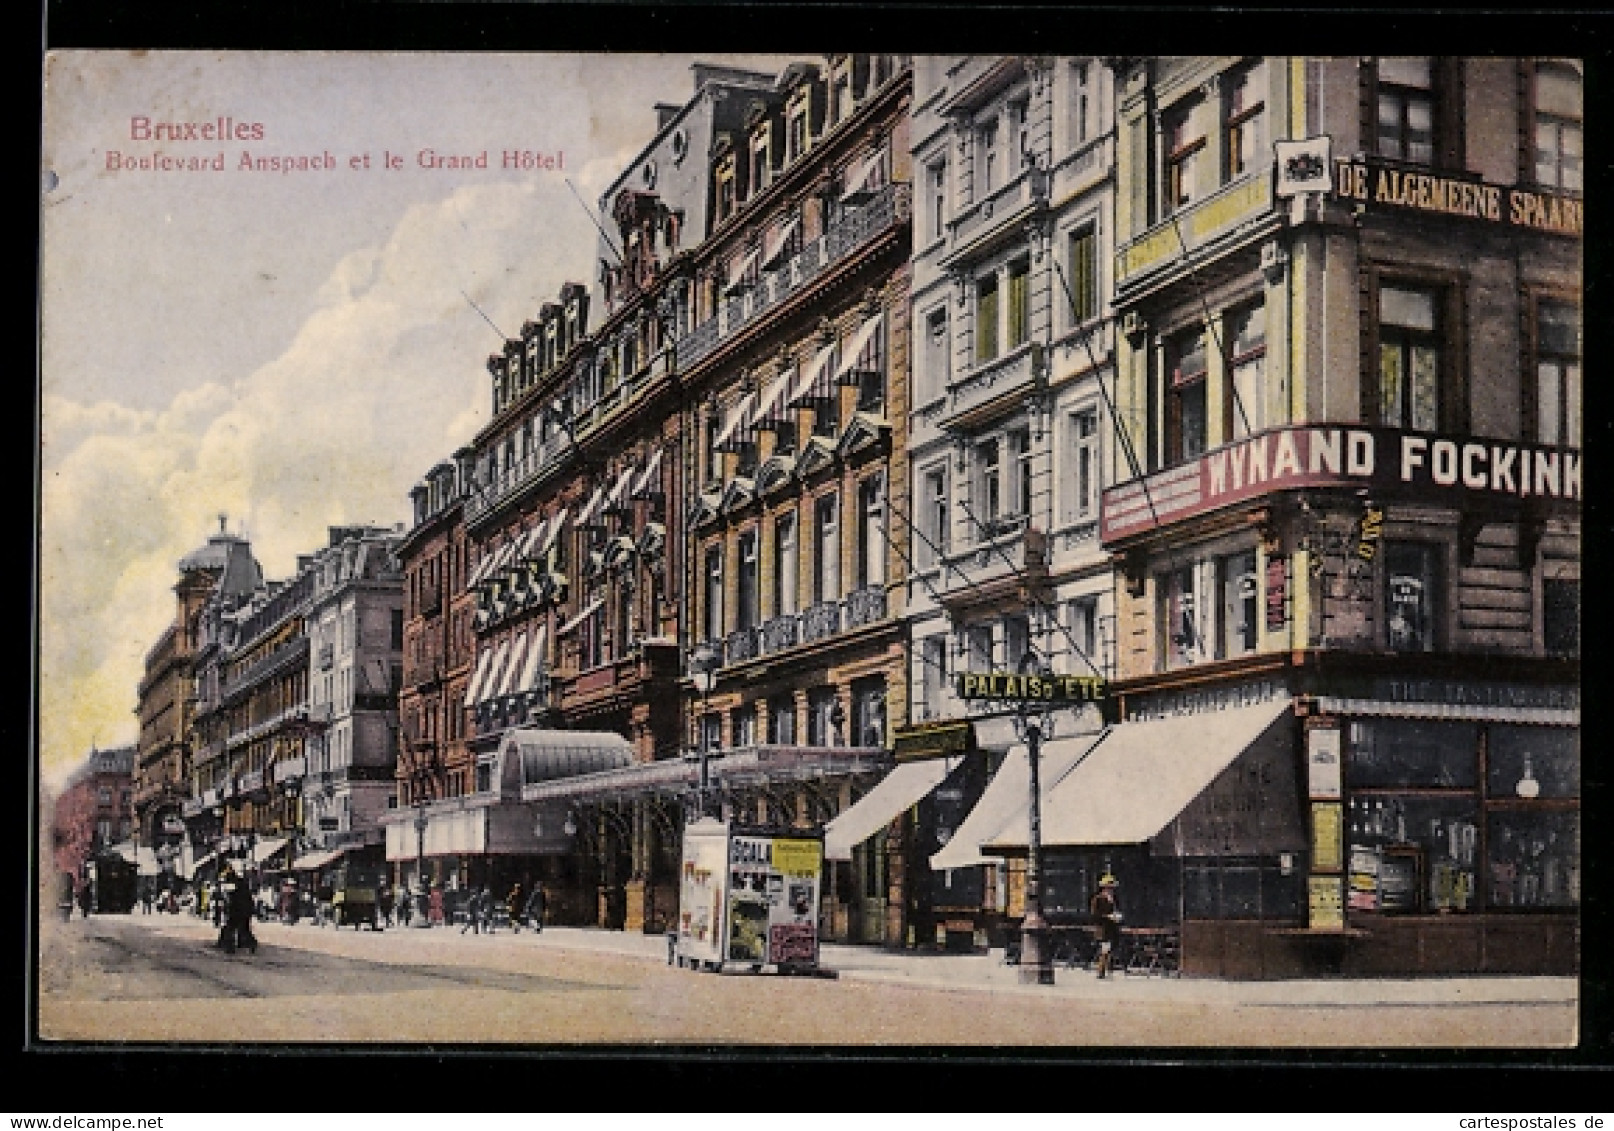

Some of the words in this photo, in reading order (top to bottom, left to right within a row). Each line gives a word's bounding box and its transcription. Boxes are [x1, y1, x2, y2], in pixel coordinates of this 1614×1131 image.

[1338, 163, 1368, 199] DE
[1375, 168, 1501, 222] ALGEMEENE
[1207, 429, 1375, 497] WYNAND
[964, 676, 1042, 698] PALAIS
